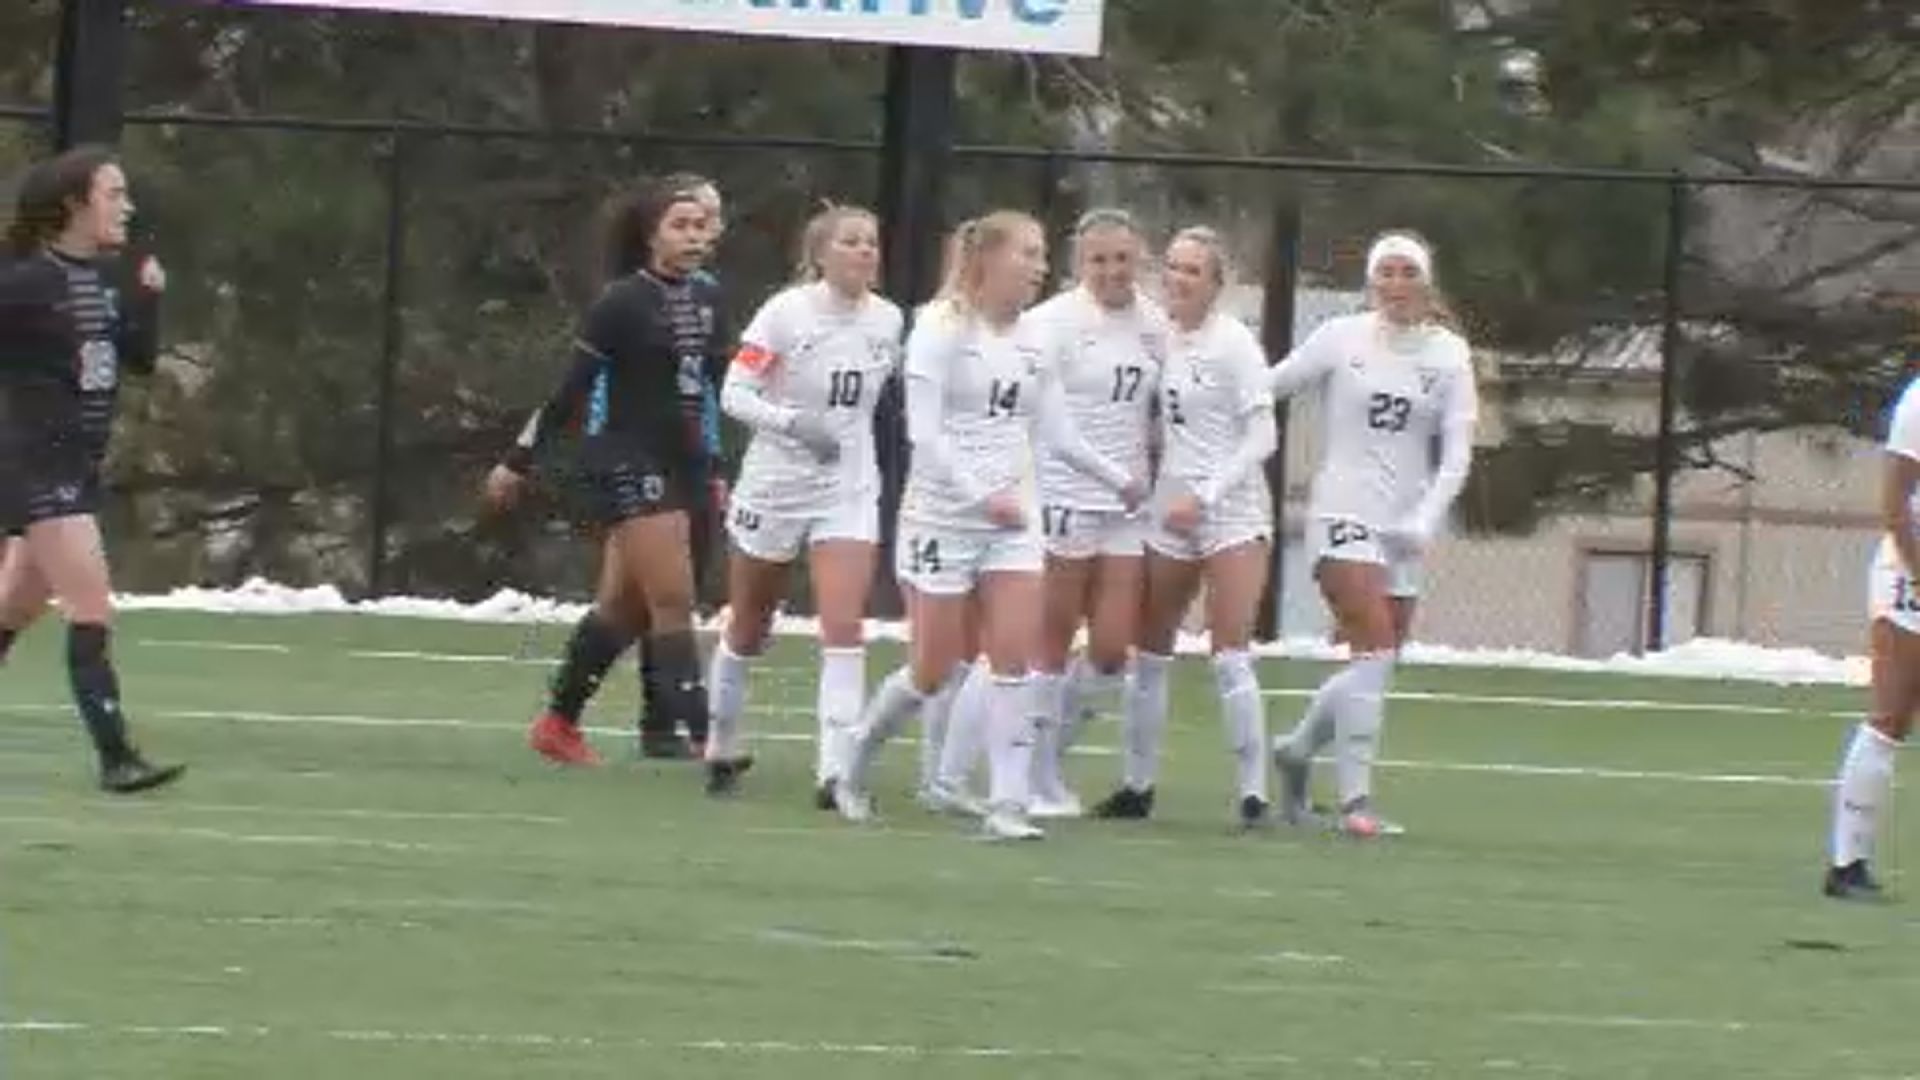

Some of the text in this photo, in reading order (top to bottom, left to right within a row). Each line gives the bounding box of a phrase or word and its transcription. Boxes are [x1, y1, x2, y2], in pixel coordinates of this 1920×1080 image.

[828, 370, 863, 407] 10
[989, 379, 1020, 417] 14
[1112, 365, 1141, 402] 17
[1368, 392, 1411, 432] 23
[1042, 505, 1071, 536] 17
[911, 537, 941, 574] 14
